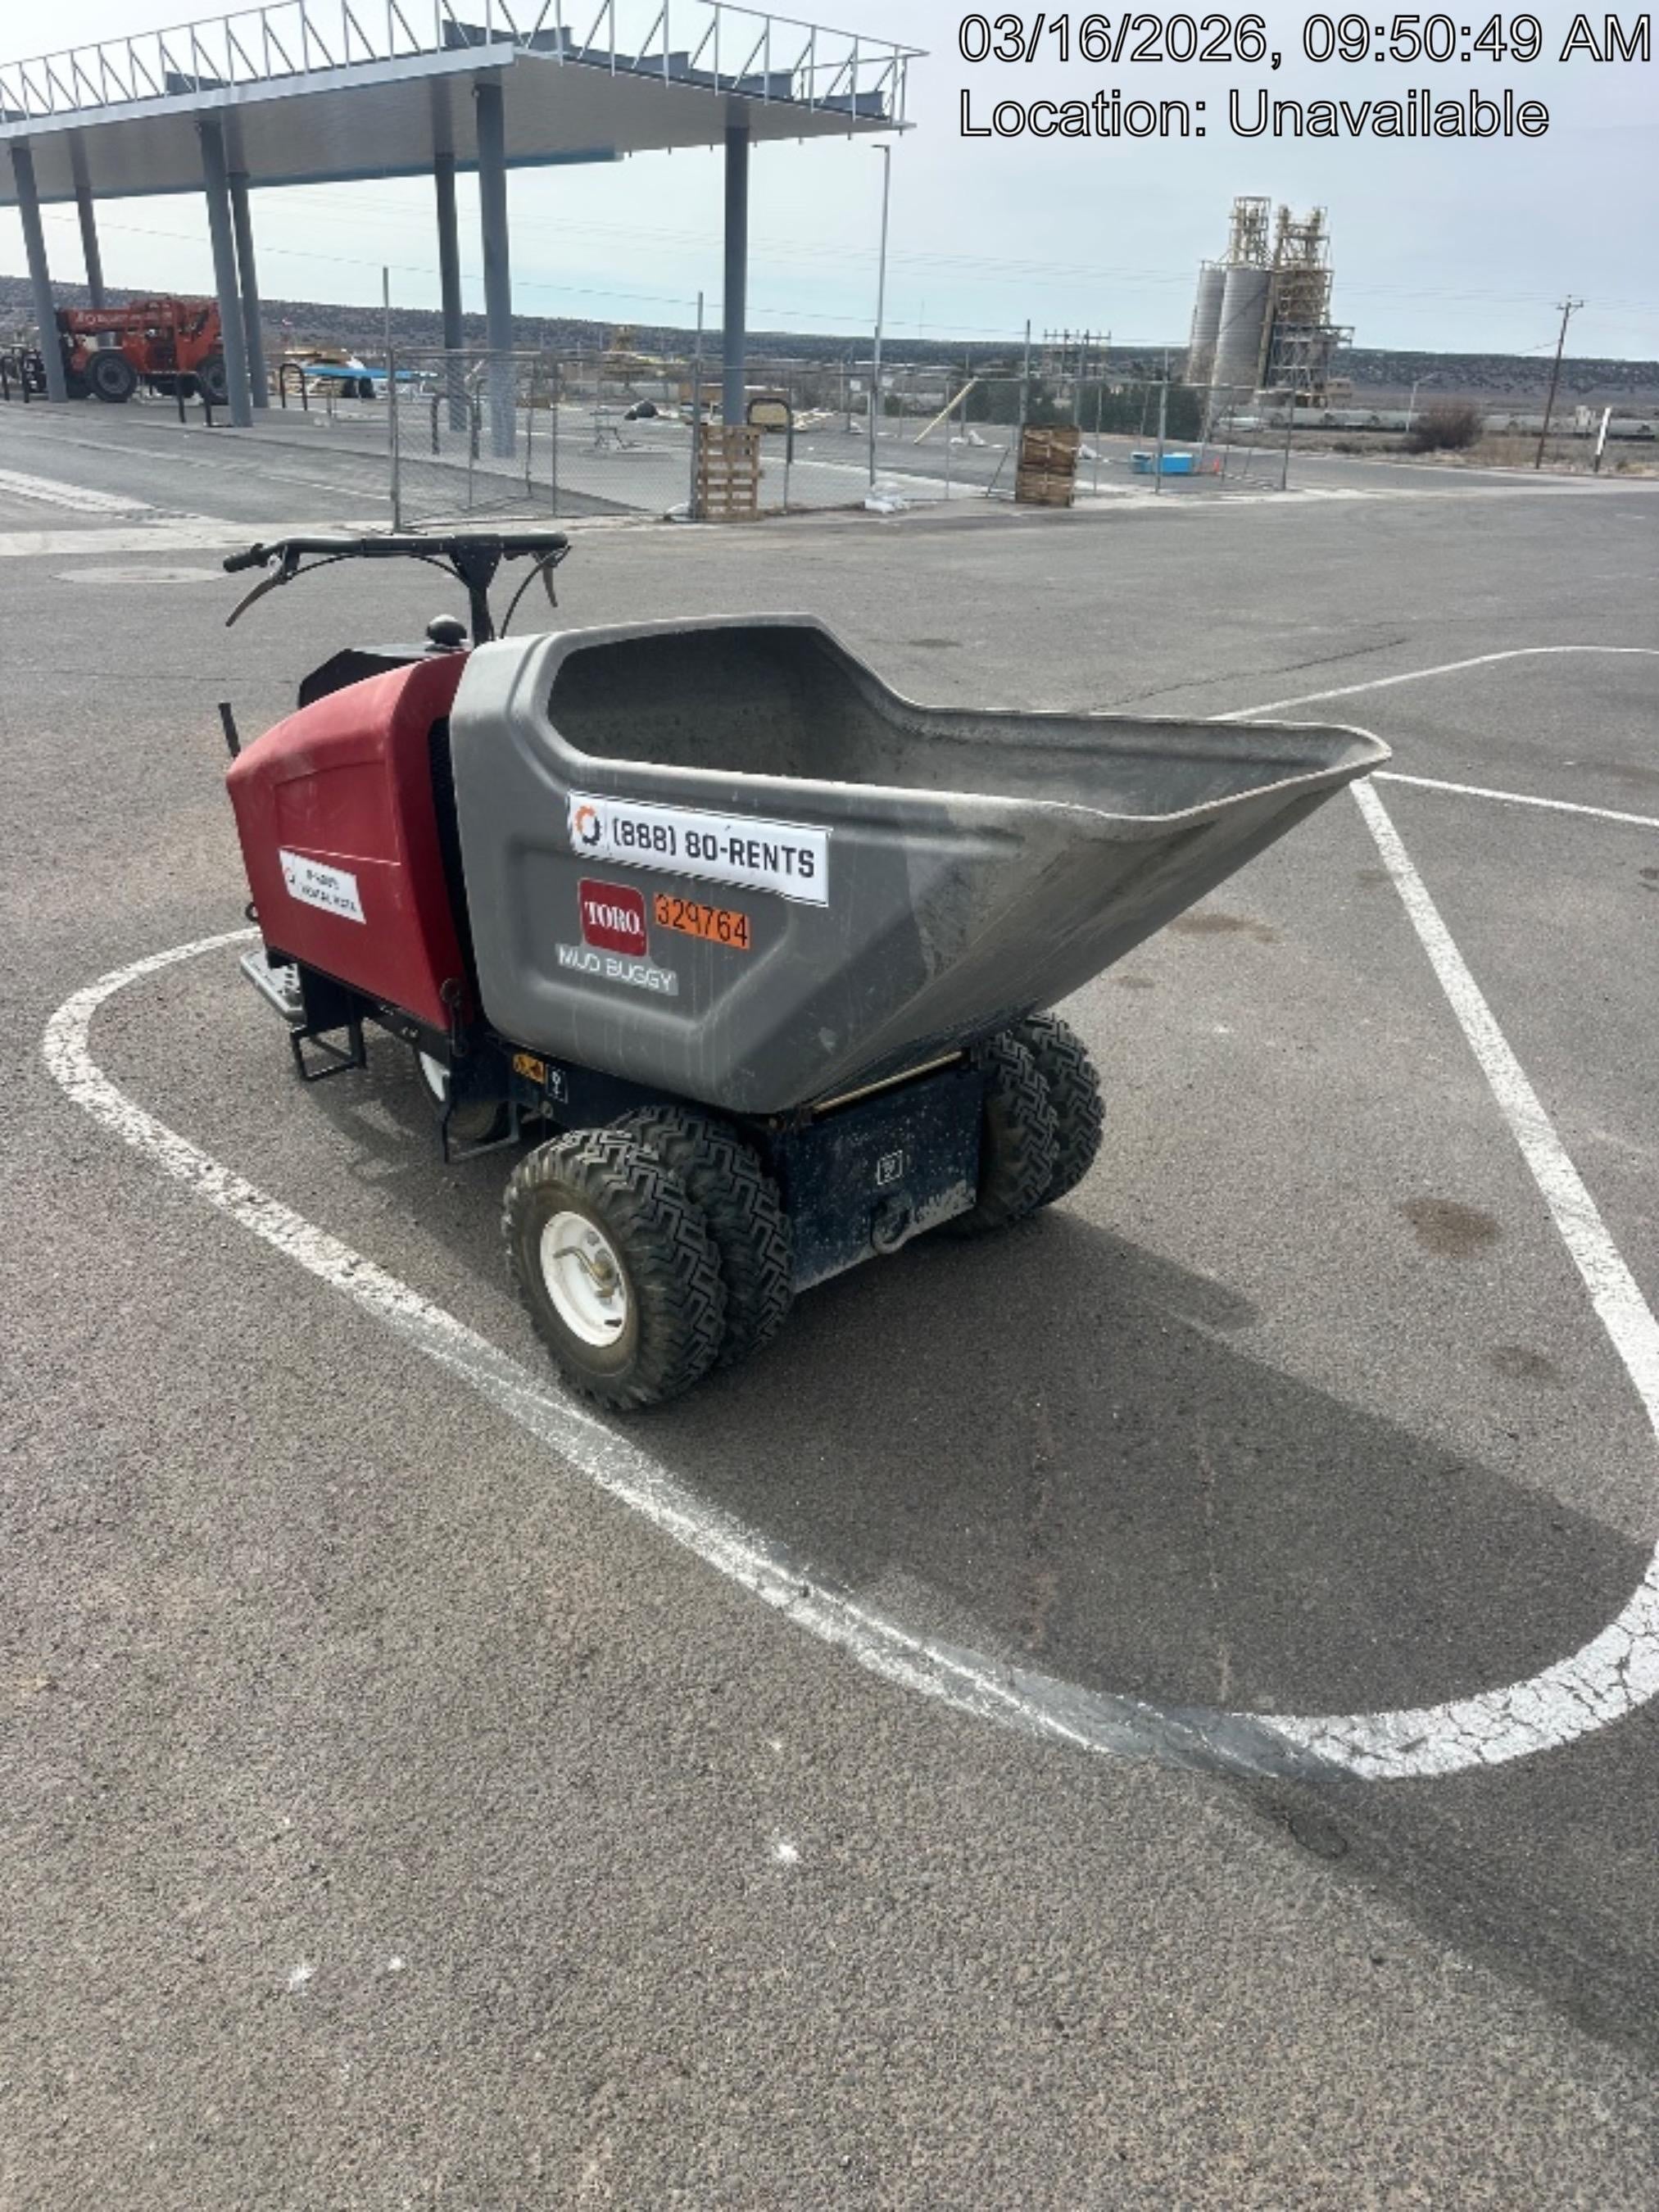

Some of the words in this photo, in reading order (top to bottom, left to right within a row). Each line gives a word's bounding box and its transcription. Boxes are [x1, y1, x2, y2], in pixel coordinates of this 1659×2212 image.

[614, 818, 677, 856] (888)
[685, 831, 815, 878] 80-RENTS
[584, 900, 641, 935] TORO
[656, 894, 748, 946] 329764
[559, 945, 600, 972] MUD
[605, 957, 676, 991] BUGGY
